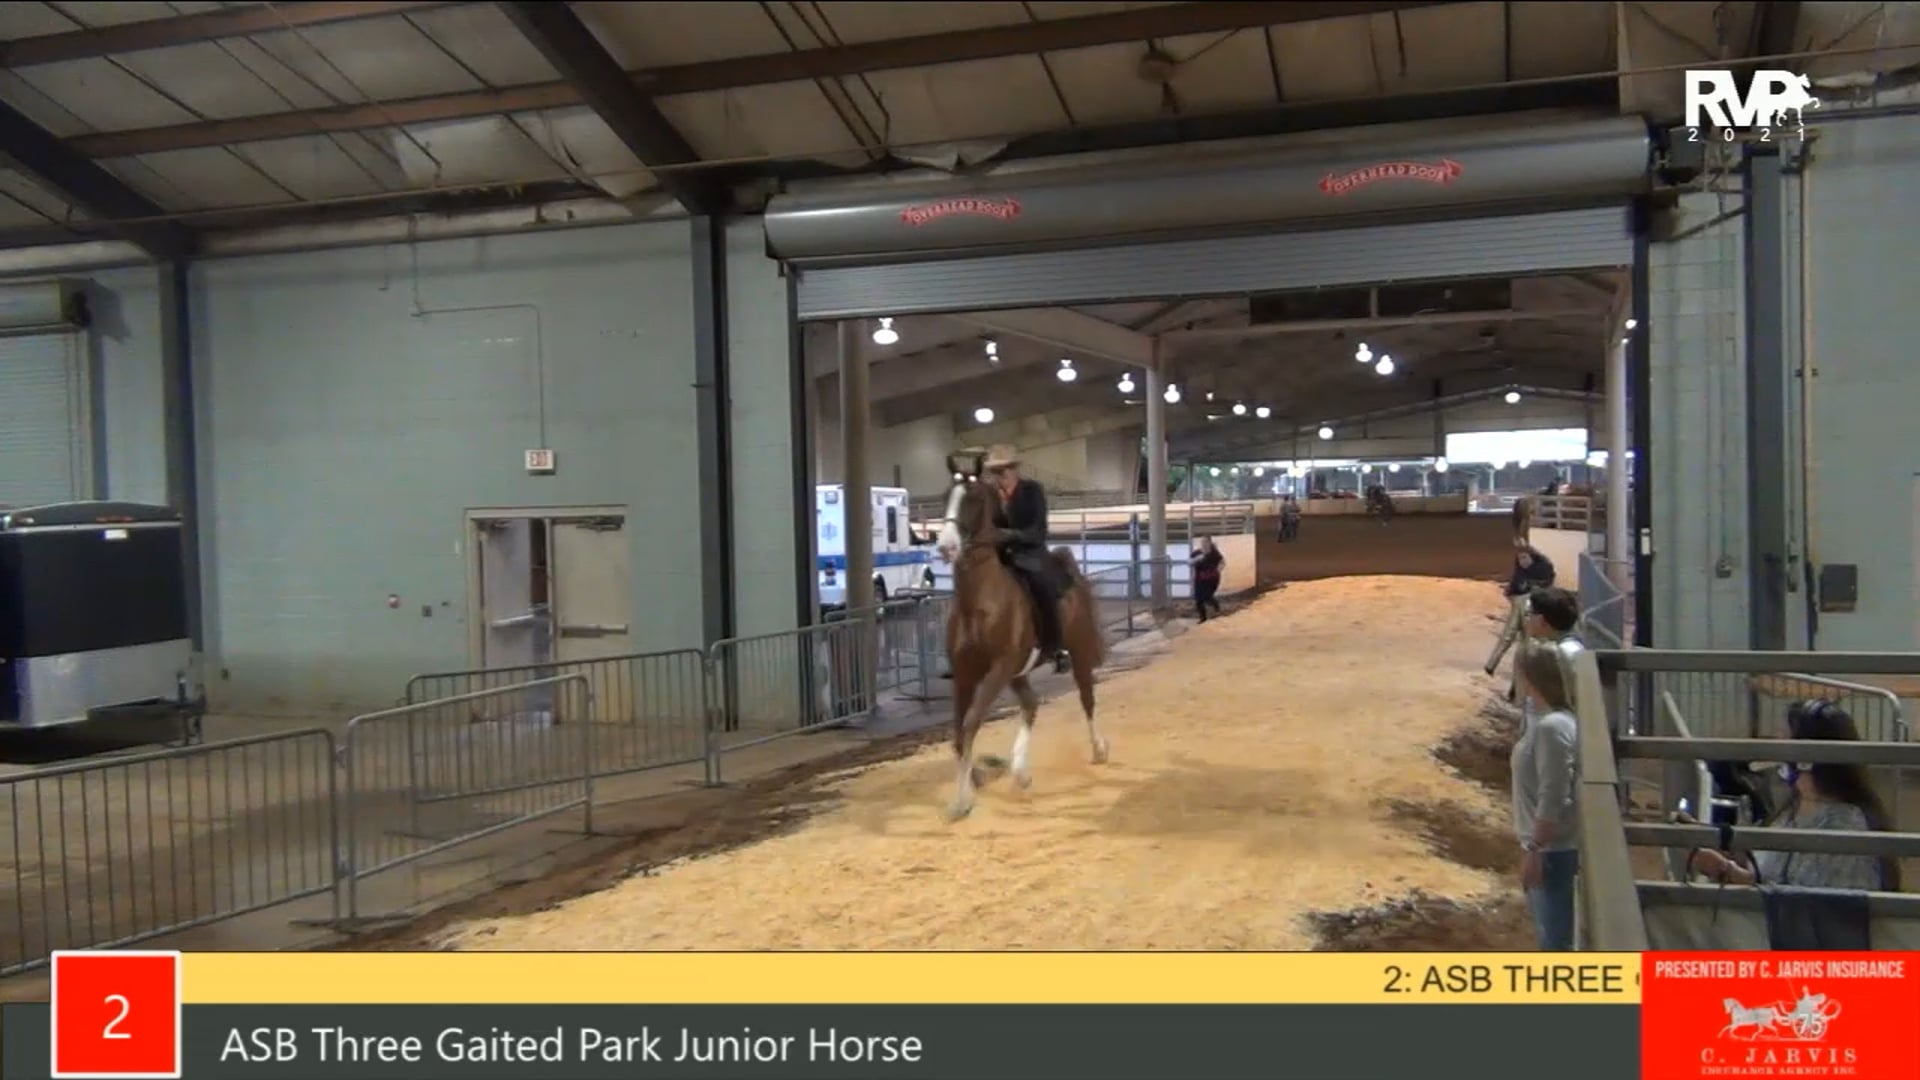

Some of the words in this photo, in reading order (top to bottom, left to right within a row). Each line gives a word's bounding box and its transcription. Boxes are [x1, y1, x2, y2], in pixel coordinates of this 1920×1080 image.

[1333, 165, 1405, 192] OVERHEAD
[1408, 165, 1445, 181] DOOR
[912, 200, 974, 222] OVERHEAD
